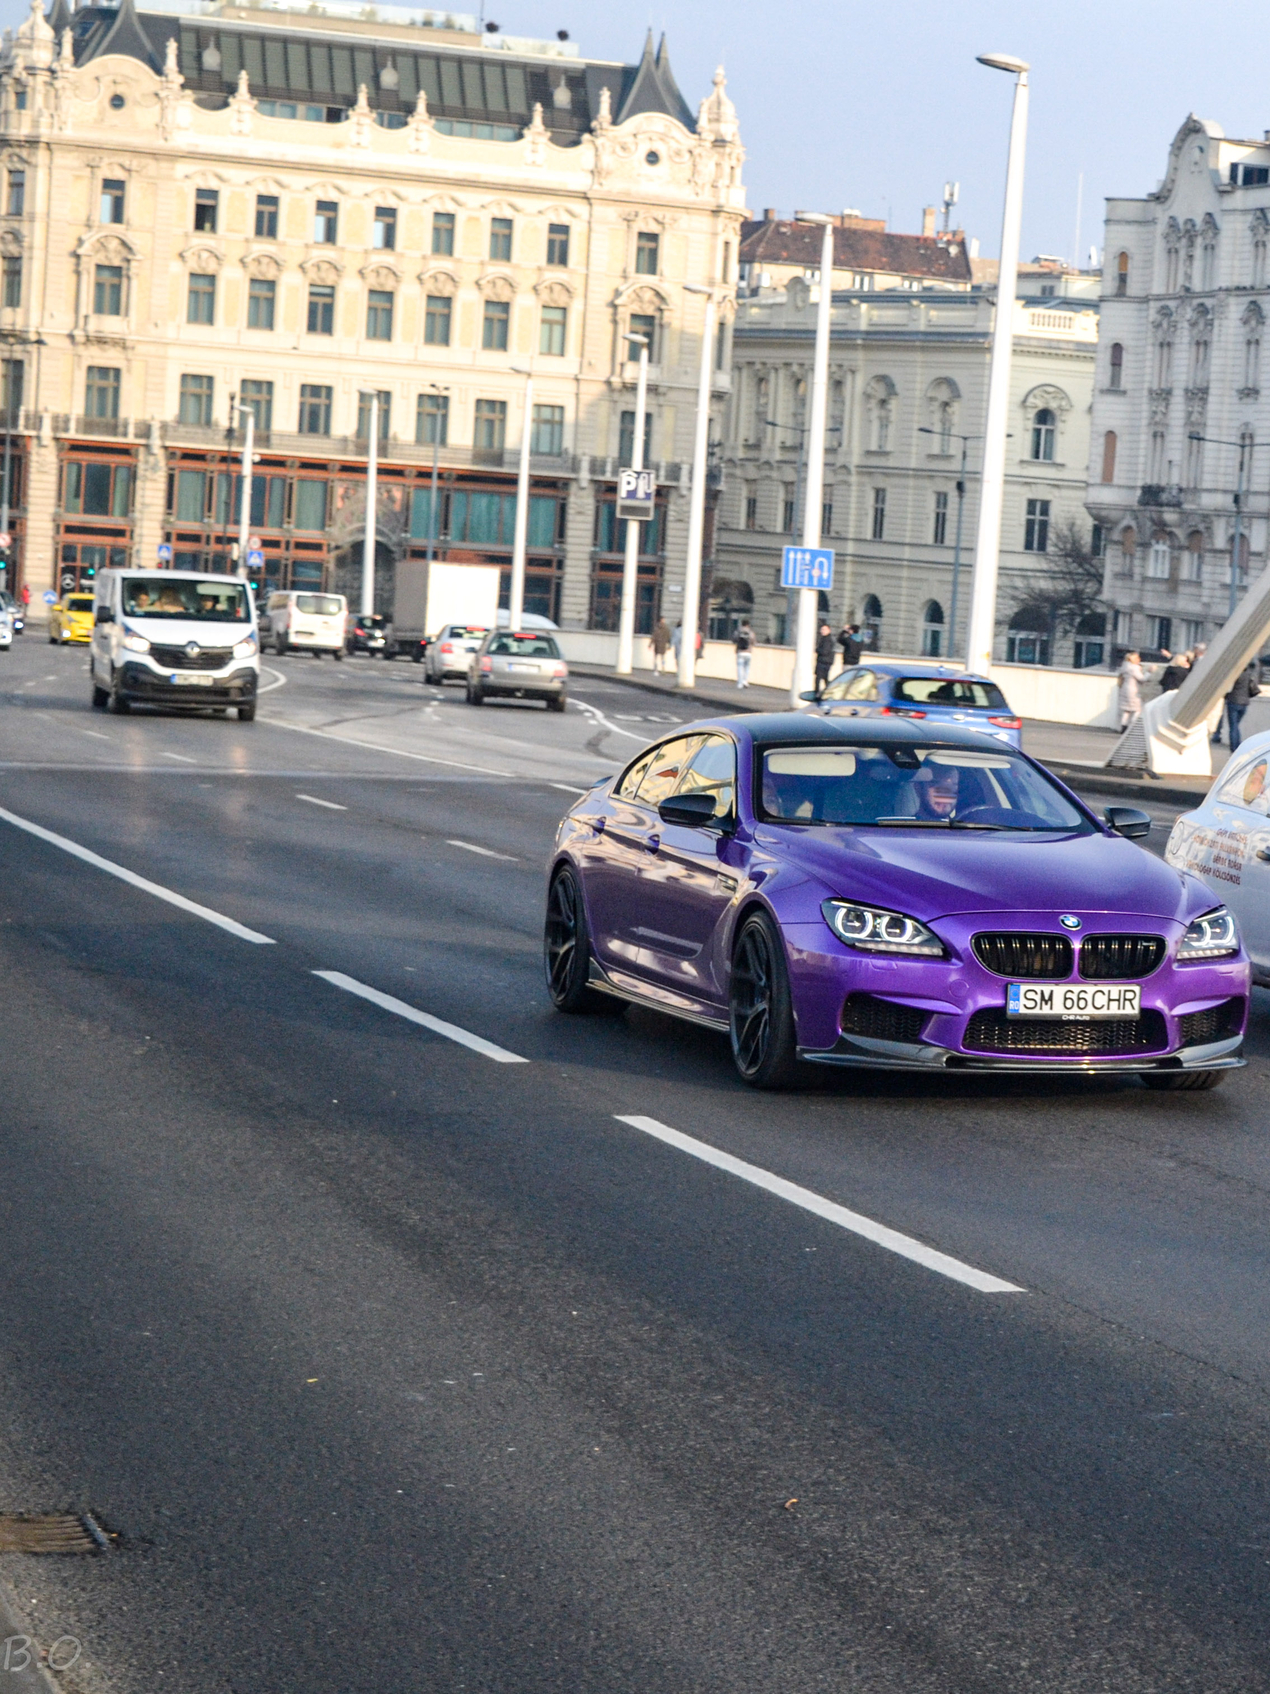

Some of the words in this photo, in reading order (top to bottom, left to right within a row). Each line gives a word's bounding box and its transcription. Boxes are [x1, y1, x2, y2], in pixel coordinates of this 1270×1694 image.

[1010, 1001, 1020, 1010] RO
[1023, 989, 1054, 1011] SM
[1063, 989, 1137, 1011] 66CHR
